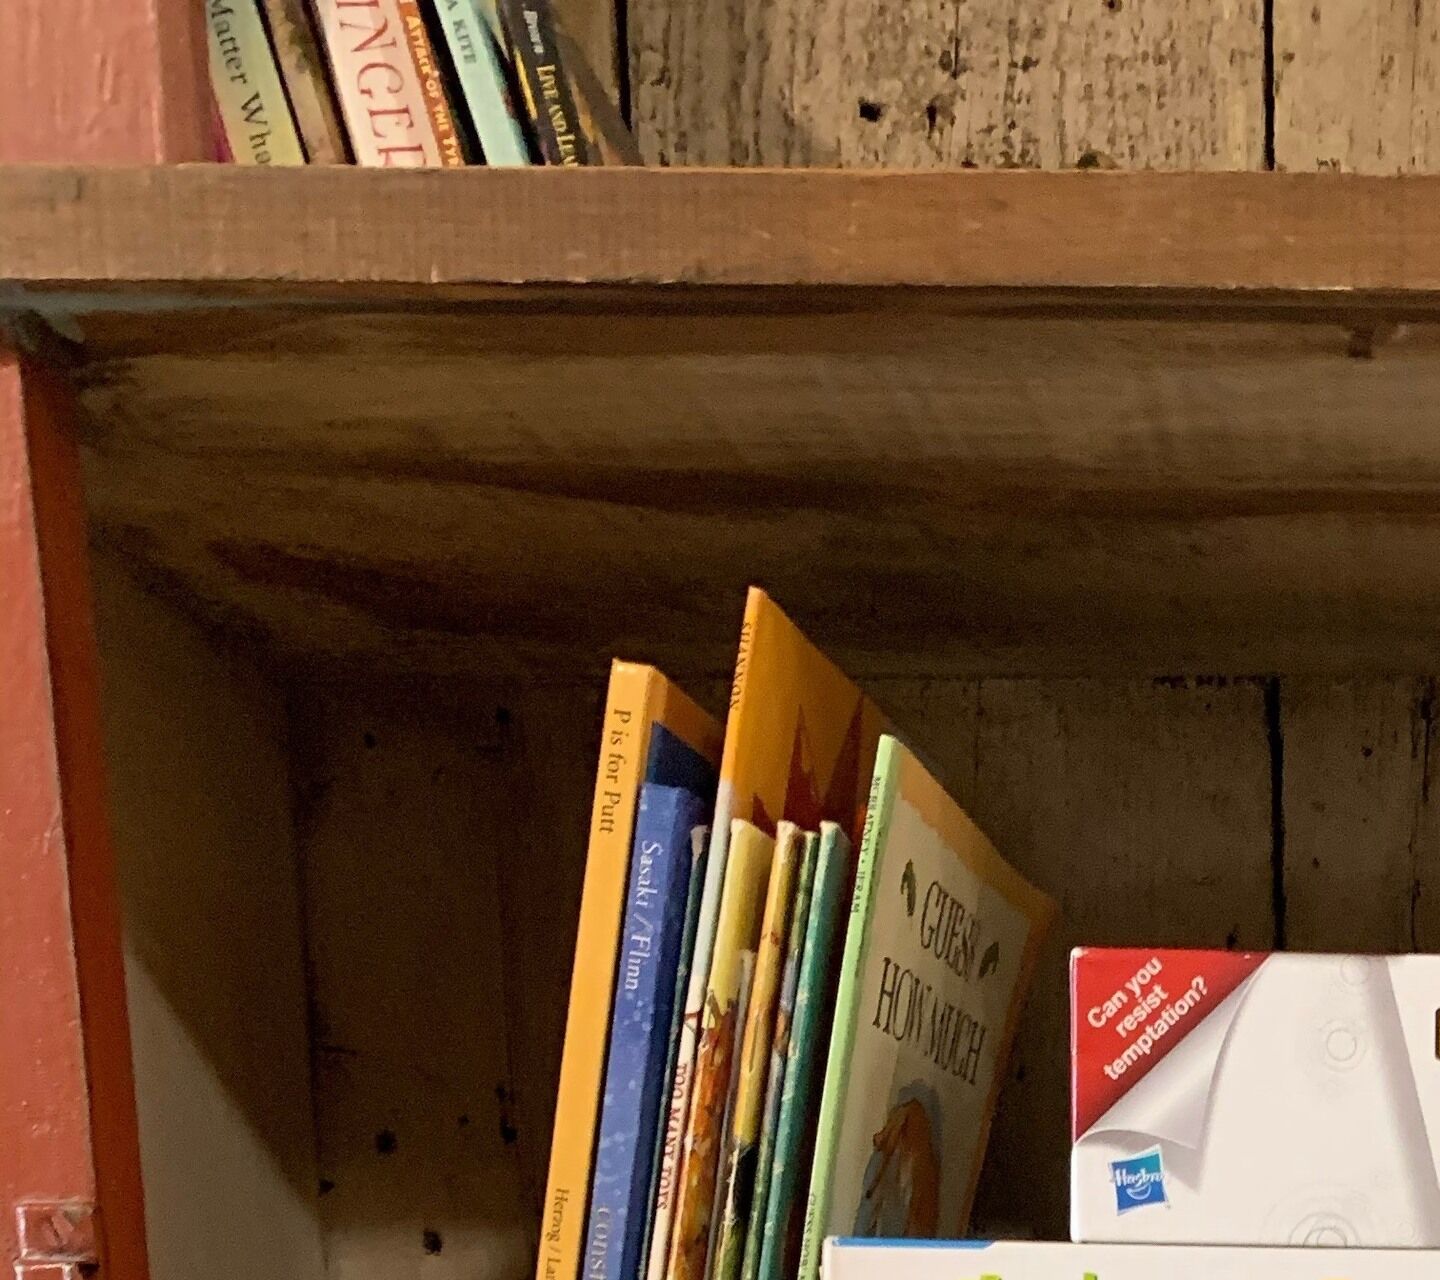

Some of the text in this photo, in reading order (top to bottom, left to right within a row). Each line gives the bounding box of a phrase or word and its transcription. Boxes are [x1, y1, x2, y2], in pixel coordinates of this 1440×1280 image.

[452, 19, 477, 64] KITE
[598, 707, 632, 835] P is for Putt
[636, 839, 664, 906] Sasaki
[624, 923, 652, 991] Flinn
[919, 879, 981, 982] GUESS
[872, 956, 932, 1044] HOW
[1087, 956, 1164, 1029] Can you
[1103, 974, 1209, 1081] temptation?
[1115, 982, 1170, 1039] resist
[923, 995, 988, 1086] MUCH
[656, 1061, 689, 1211] TOO MANY TOYS
[1112, 1166, 1168, 1189] Hasbro
[546, 1187, 571, 1244] Herzog
